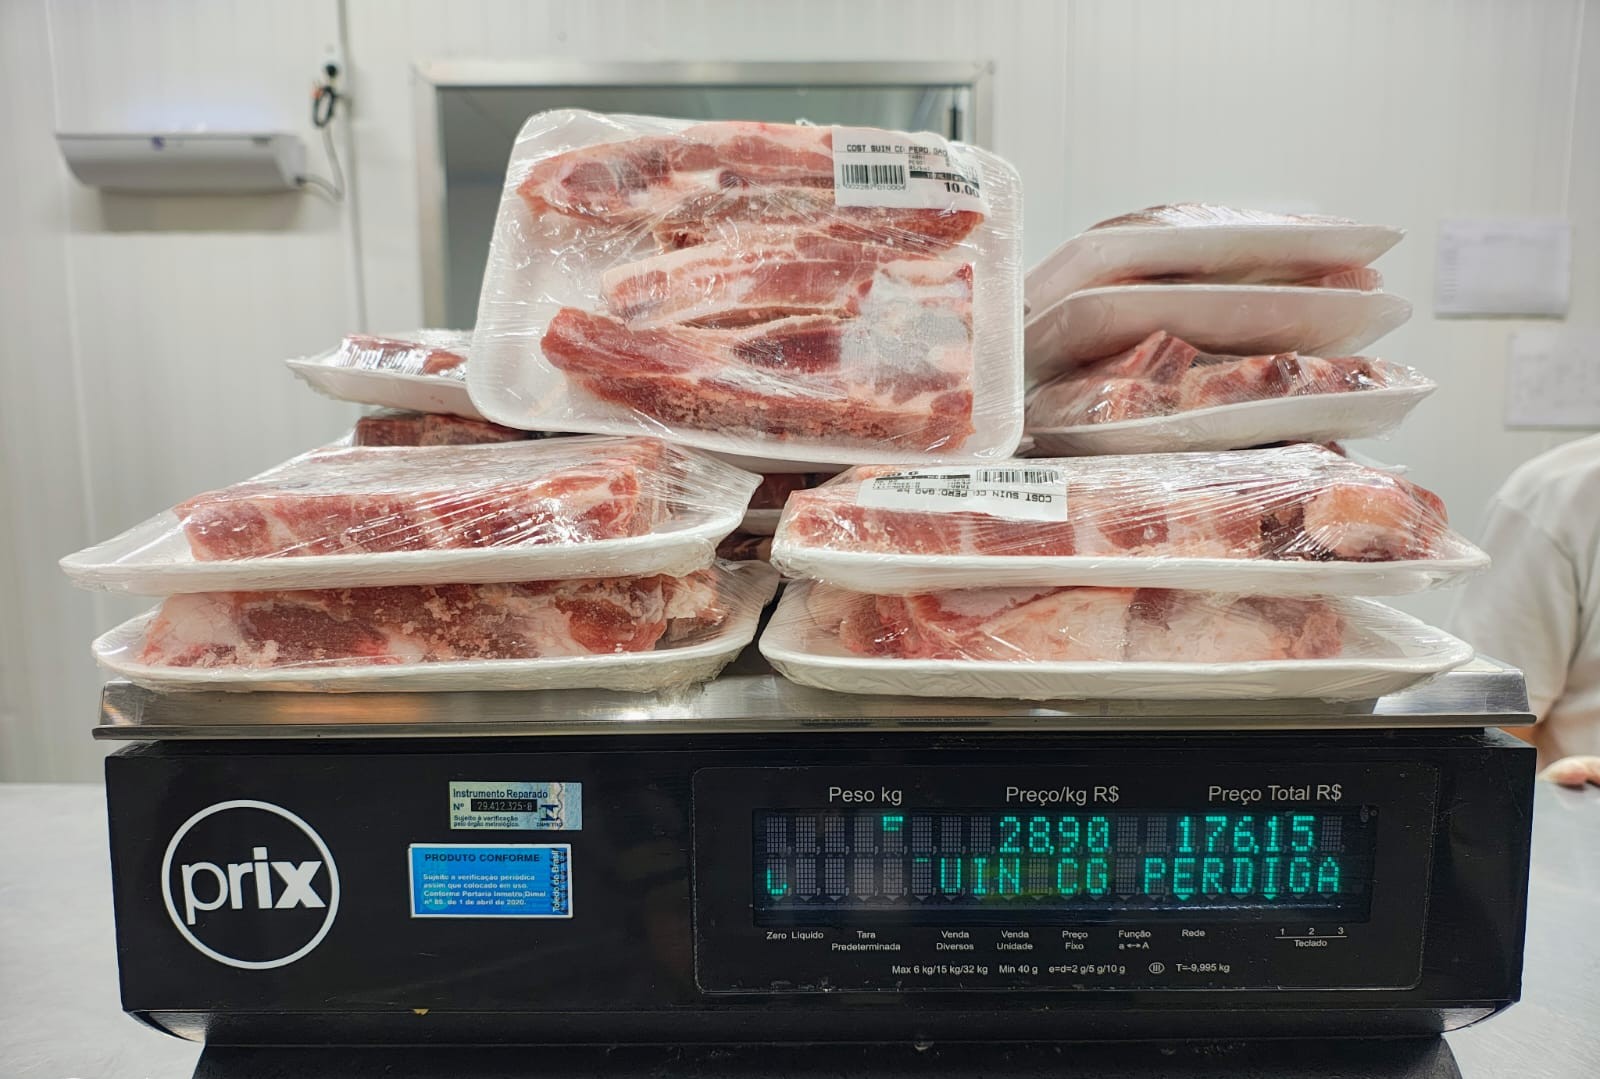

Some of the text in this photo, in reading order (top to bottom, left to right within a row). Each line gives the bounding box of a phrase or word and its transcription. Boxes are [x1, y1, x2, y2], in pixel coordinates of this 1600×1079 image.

[846, 144, 866, 153] COST
[870, 144, 891, 153] SUIN
[992, 490, 1019, 500] SUIN
[1025, 492, 1052, 503] COST
[453, 789, 548, 800] Instrumento Reparado
[829, 786, 903, 806] Peso kg
[1006, 785, 1119, 806] Preço/kg R$
[1208, 784, 1342, 805] Preço Total R$
[425, 853, 541, 862] PRODUTO CONFORME
[914, 857, 1340, 895] UIN CG PERDIGA
[181, 846, 327, 925] prix
[552, 887, 560, 912] Toledo
[766, 931, 787, 940] Zero
[856, 930, 876, 939] Tara
[941, 930, 970, 939] Venda
[1001, 930, 1030, 939] Venda
[1061, 930, 1089, 940] Preço
[1118, 930, 1152, 940] Função
[1181, 929, 1206, 938] Rede
[1280, 926, 1345, 936] 1 2 3
[831, 942, 901, 951] Predeterminada
[936, 942, 974, 951] Diversos
[996, 942, 1033, 950] Unidade
[1065, 942, 1084, 950] Fixo
[1294, 939, 1328, 948] Teclado
[892, 965, 989, 976] Max 6 kg/15 kg/32 kg
[999, 964, 1038, 975] Min 40 g
[1080, 964, 1095, 975] g/5
[1096, 964, 1118, 975] g/10
[1119, 965, 1126, 975] g
[1218, 963, 1230, 974] kg
